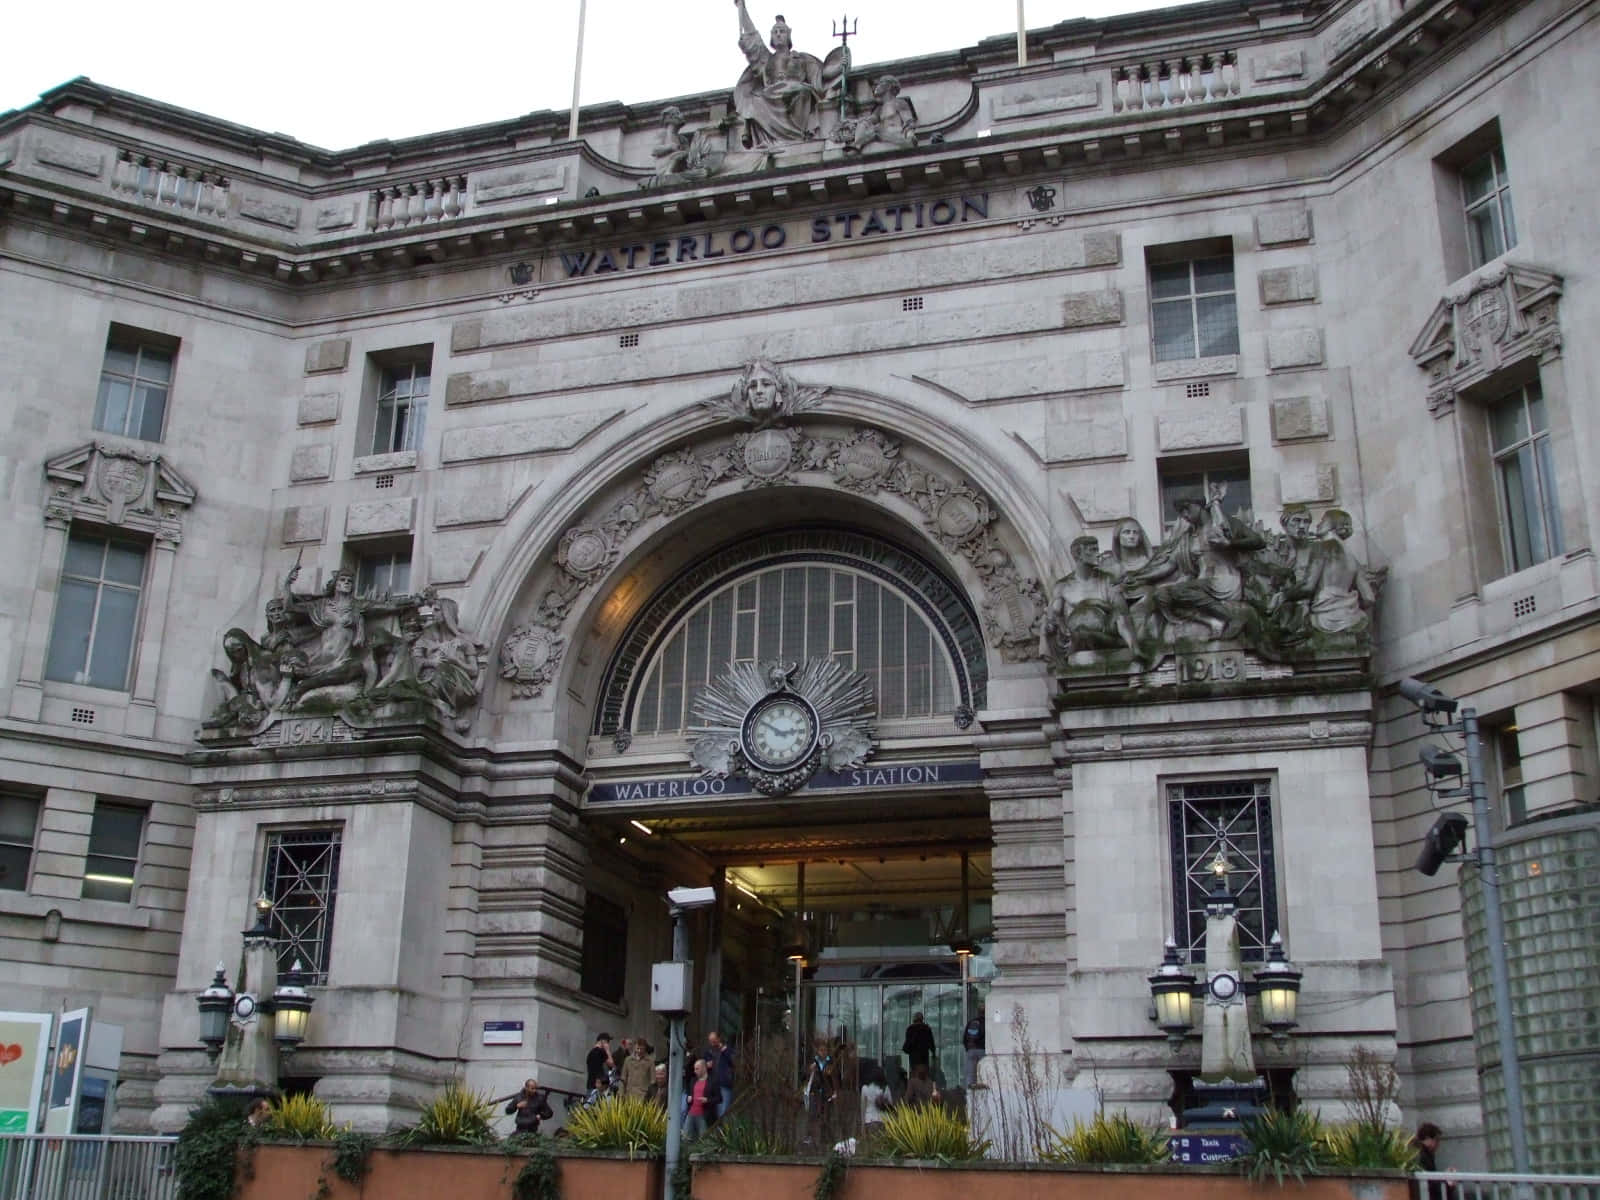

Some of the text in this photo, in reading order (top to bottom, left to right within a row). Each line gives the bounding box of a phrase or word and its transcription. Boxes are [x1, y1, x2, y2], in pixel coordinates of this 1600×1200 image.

[561, 226, 786, 276] WATERLOO
[811, 193, 989, 243] STATION
[1180, 655, 1240, 682] 1918
[283, 722, 326, 745] 1914
[615, 766, 939, 801] WATERLOO STATION
